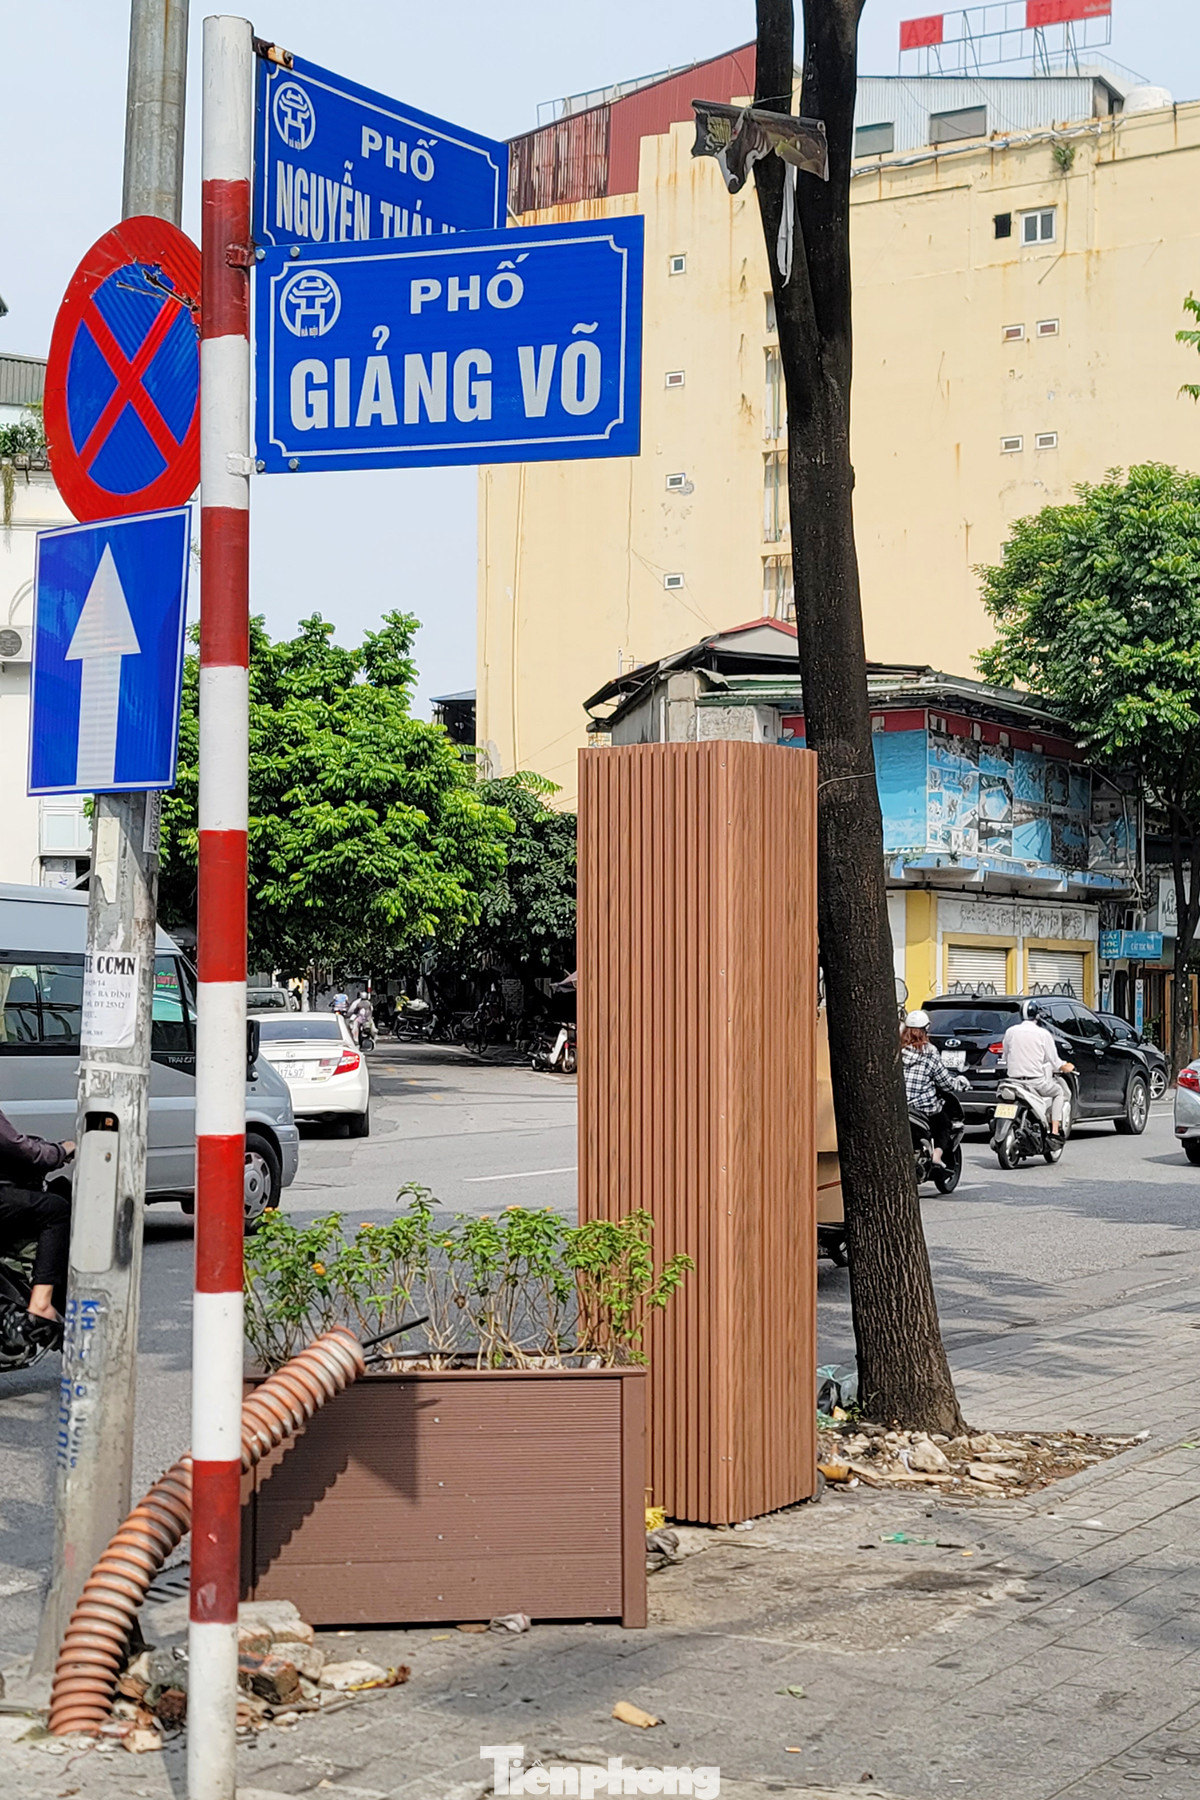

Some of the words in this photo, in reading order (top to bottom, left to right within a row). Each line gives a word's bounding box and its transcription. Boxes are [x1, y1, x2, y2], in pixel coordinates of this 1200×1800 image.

[361, 125, 438, 182] PHỐ
[276, 160, 370, 242] NGUYỄN
[410, 253, 530, 315] PHỐ
[290, 324, 492, 431] GIẢNG
[517, 321, 602, 418] VÕ
[97, 956, 136, 976] CCMN
